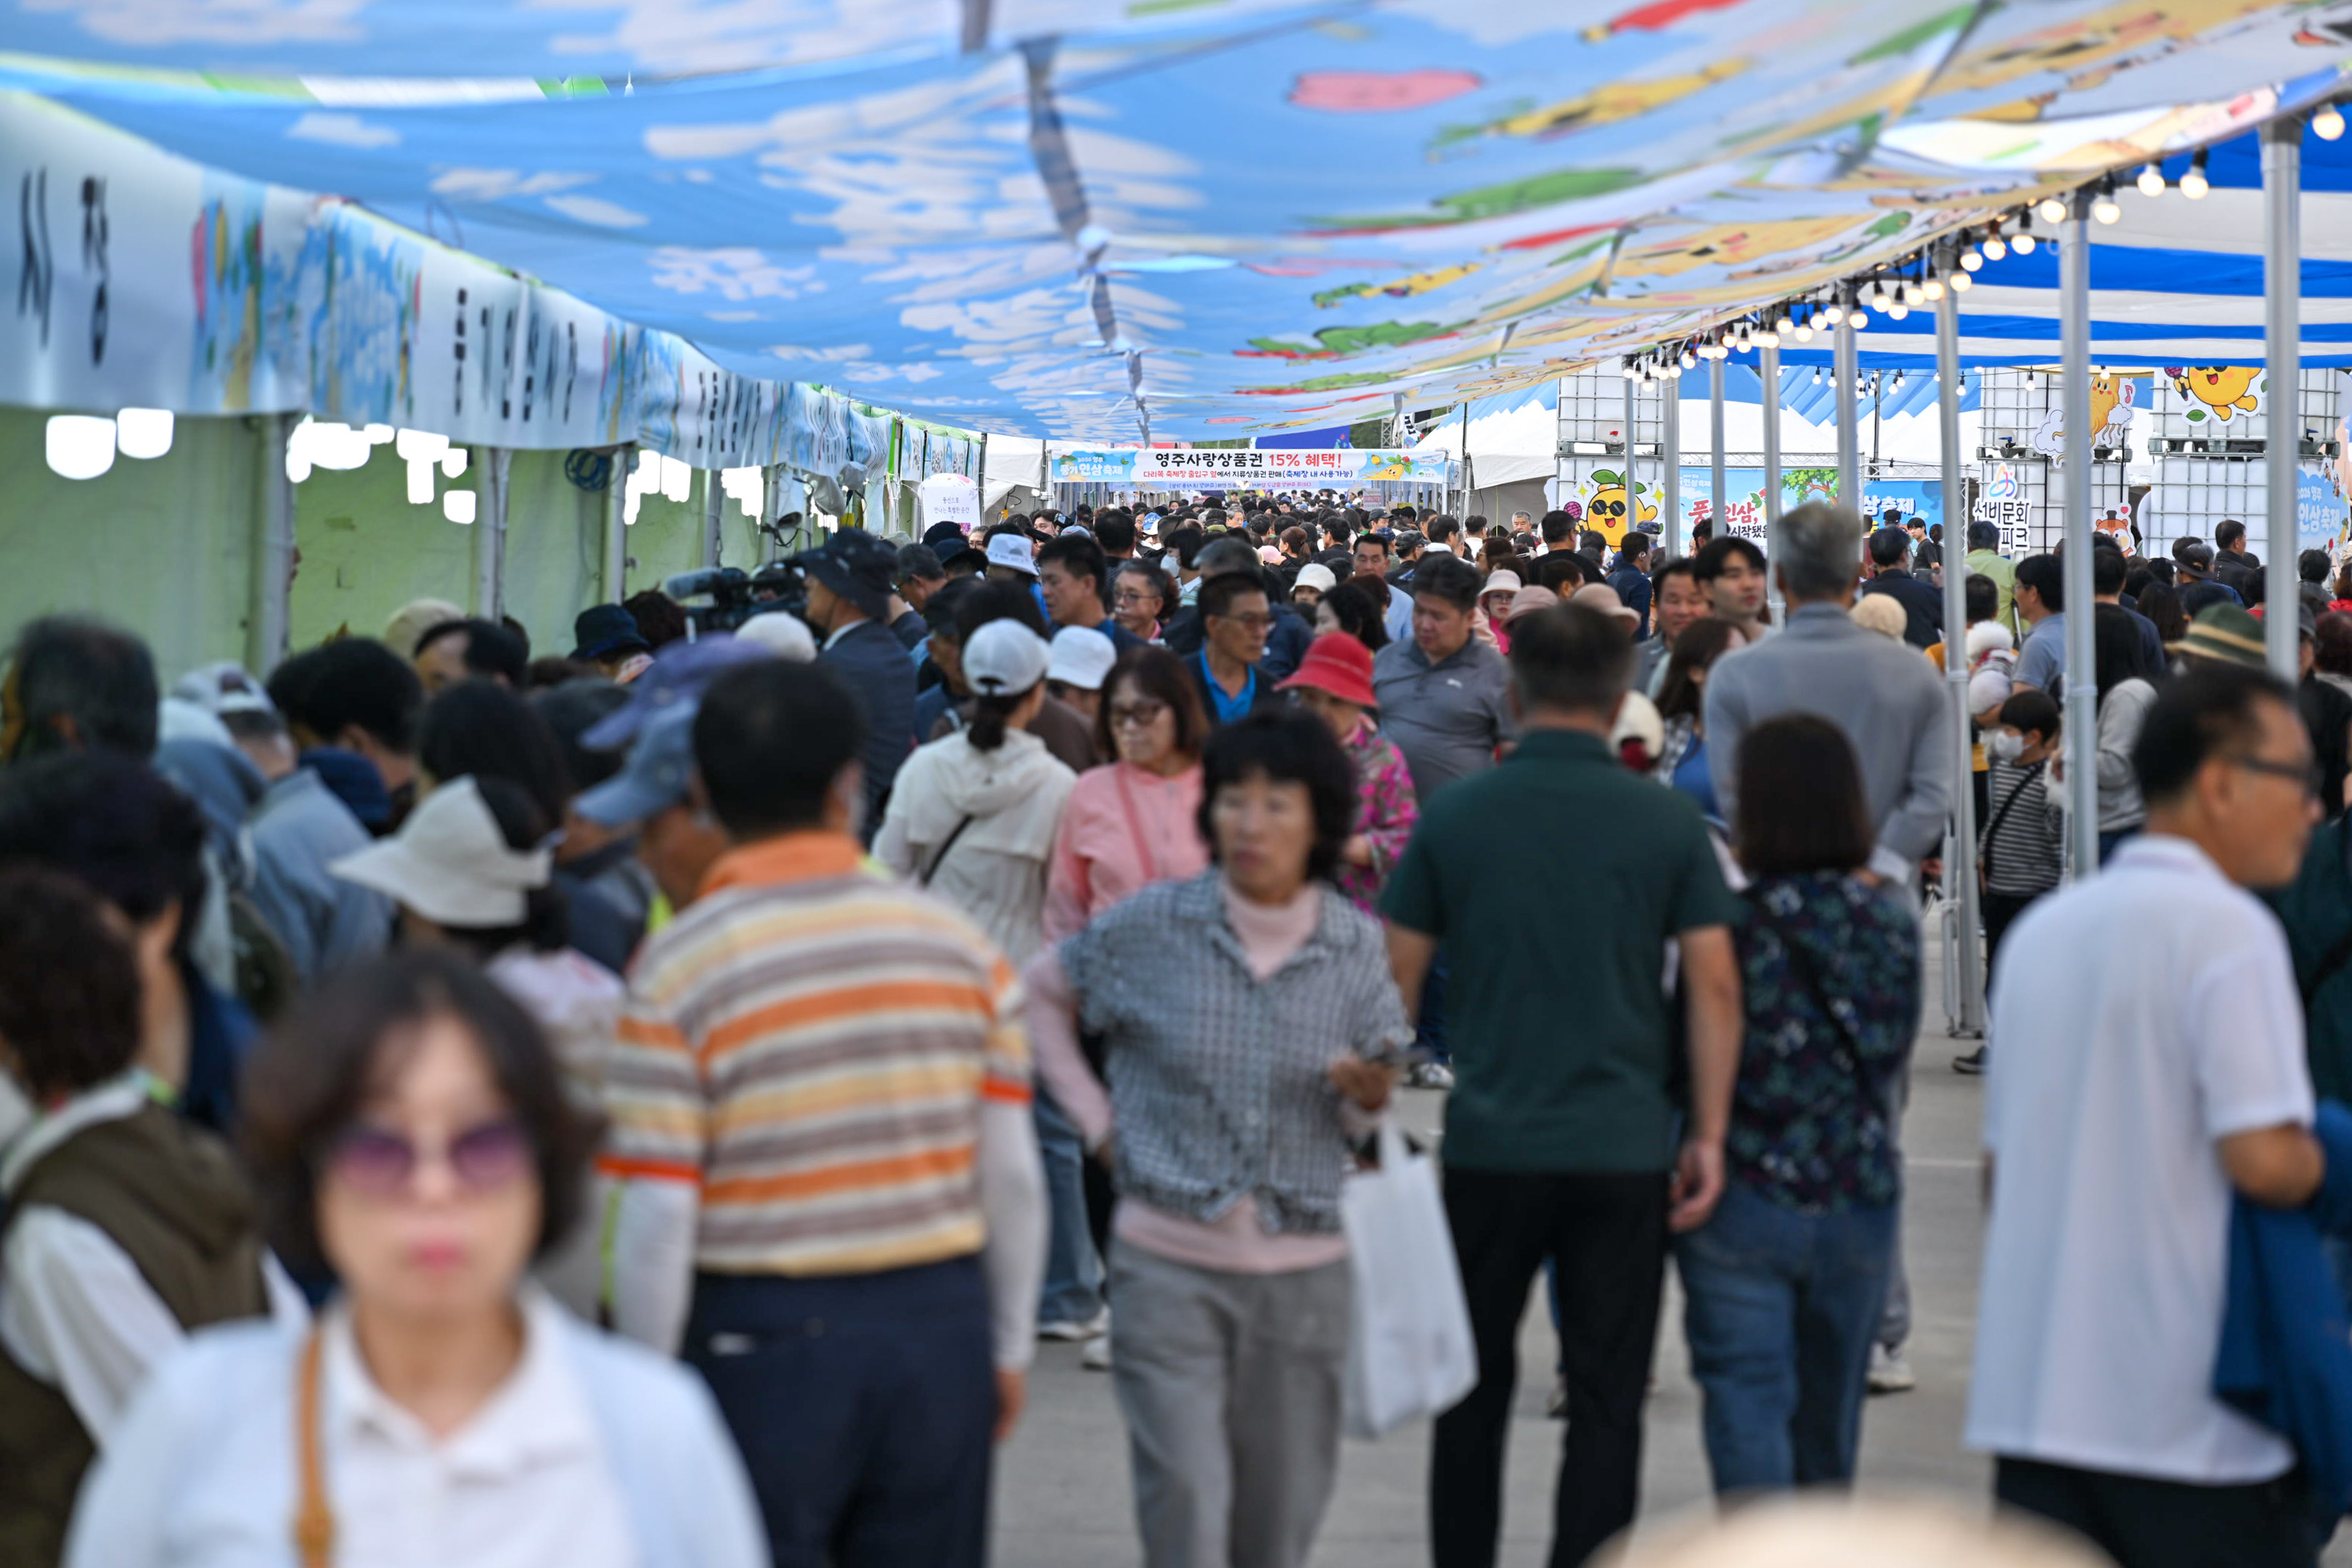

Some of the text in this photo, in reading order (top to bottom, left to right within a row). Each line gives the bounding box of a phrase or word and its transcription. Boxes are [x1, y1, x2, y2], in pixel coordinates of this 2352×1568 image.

[1156, 452, 1342, 468] 영주사랑상품권 15% 혜택!
[1688, 499, 1758, 525] 풍인삼,
[1975, 501, 2030, 525] 선비문화
[2298, 502, 2340, 532] 인삼축제
[1996, 528, 2028, 550] 파크
